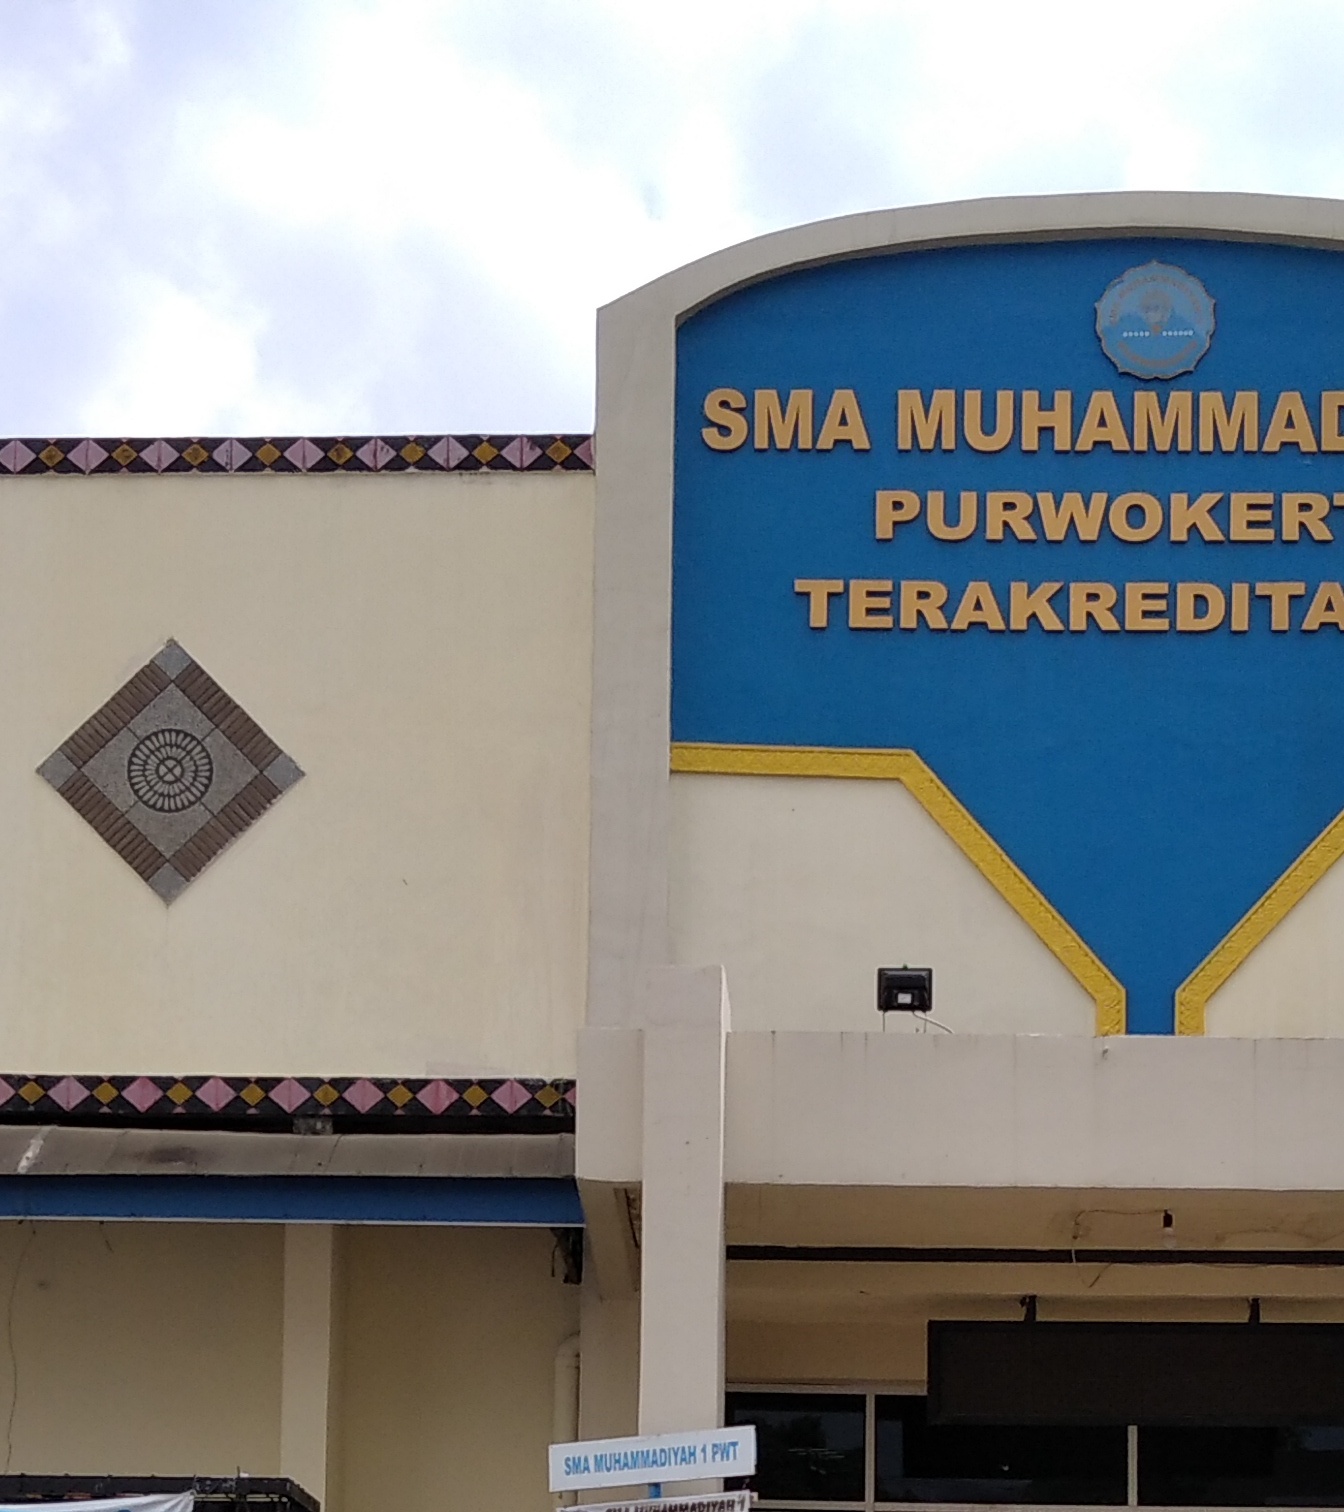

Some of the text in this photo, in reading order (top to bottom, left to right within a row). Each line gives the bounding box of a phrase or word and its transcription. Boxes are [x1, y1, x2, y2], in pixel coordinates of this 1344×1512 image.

[701, 388, 869, 453] SMA
[564, 1441, 740, 1476] SMA MUHAMMADIYAH 1 PWT
